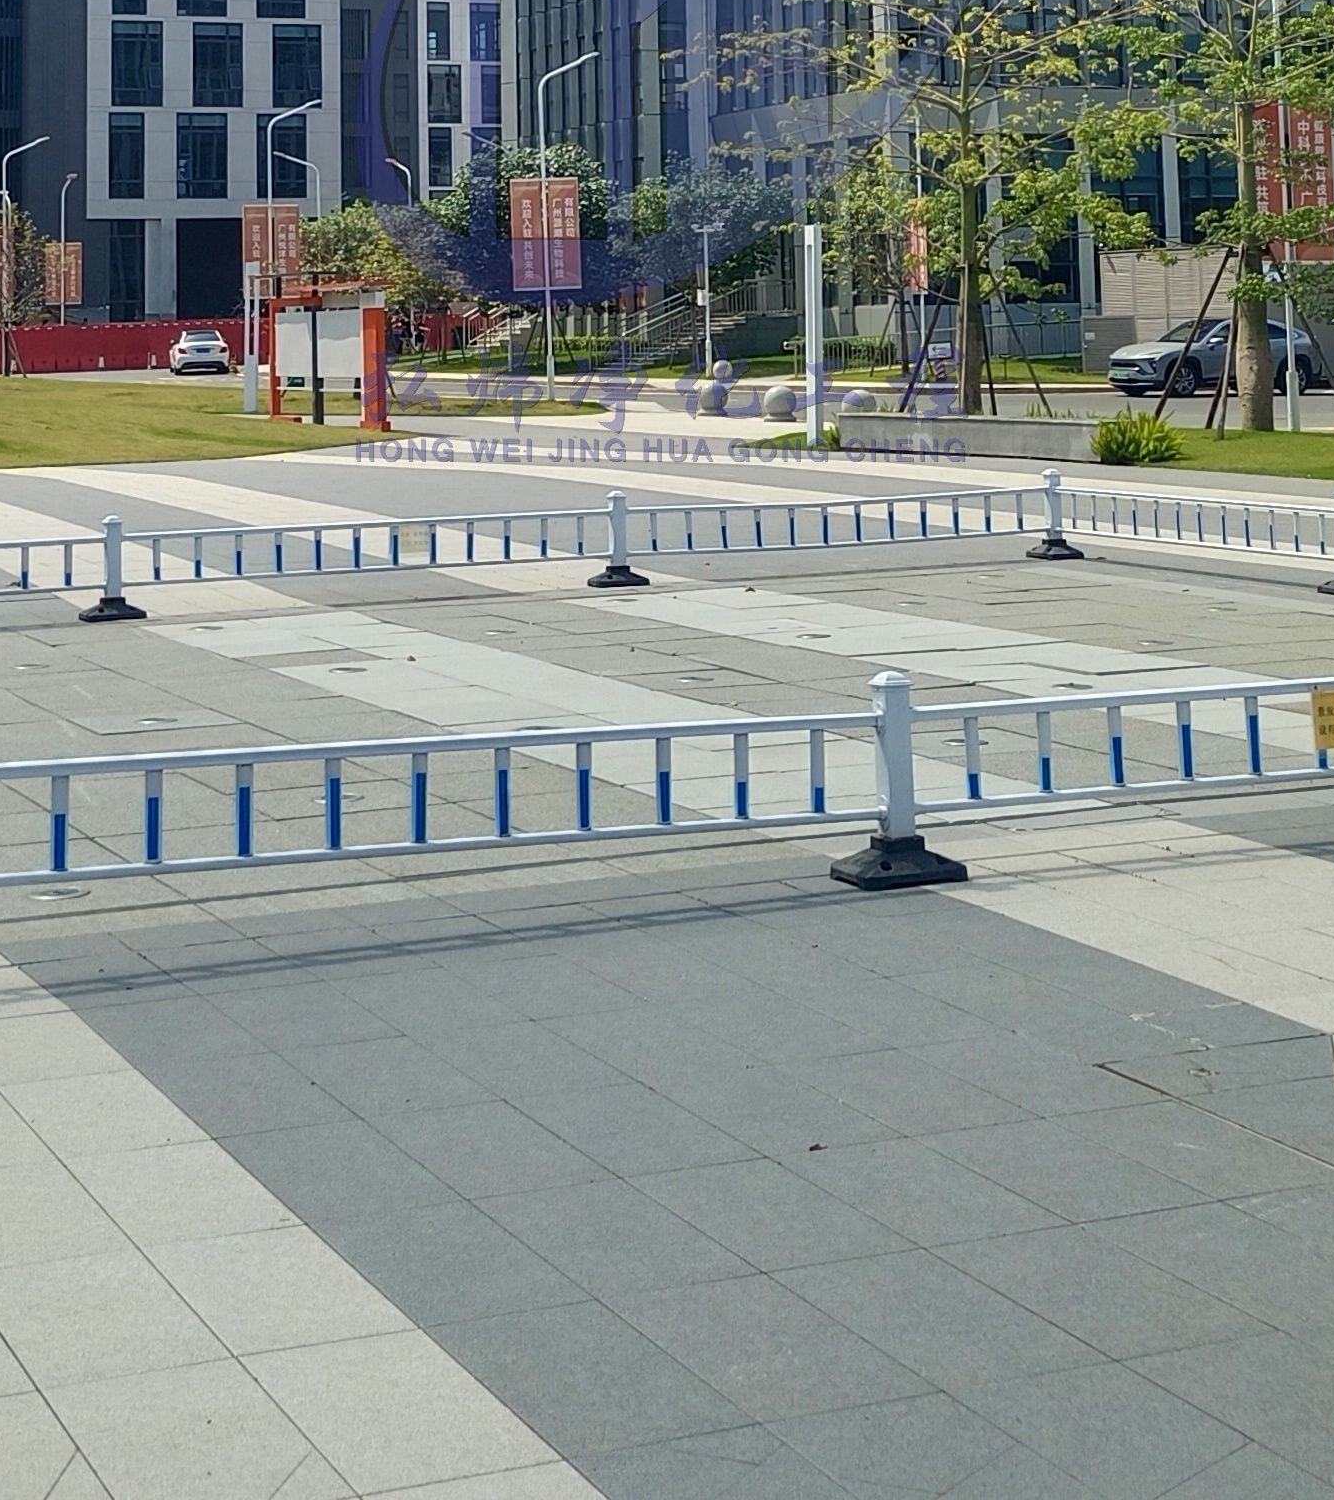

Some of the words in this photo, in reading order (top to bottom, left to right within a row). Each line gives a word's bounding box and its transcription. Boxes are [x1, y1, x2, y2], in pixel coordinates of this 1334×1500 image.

[521, 199, 533, 238] 欢迎入驻
[564, 197, 575, 237] 有限公司
